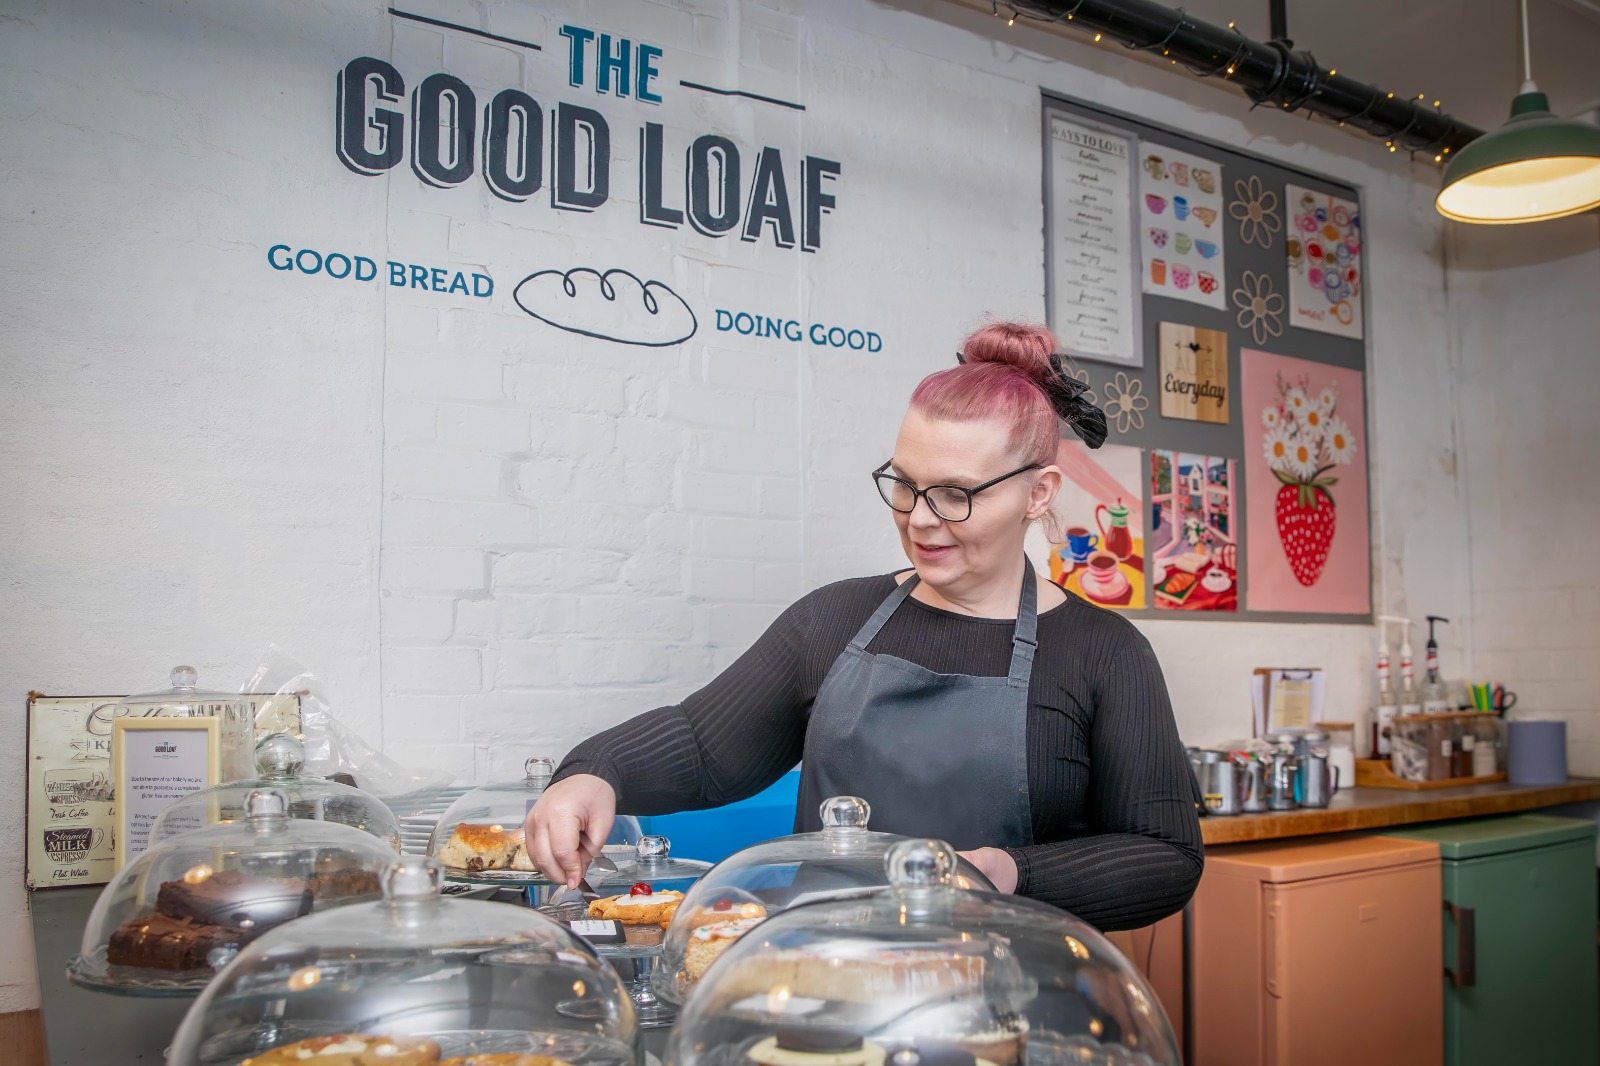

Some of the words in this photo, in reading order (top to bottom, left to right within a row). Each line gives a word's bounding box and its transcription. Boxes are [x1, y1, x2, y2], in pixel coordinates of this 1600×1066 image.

[559, 24, 664, 104] THE
[1051, 125, 1081, 143] WAYS
[1081, 133, 1097, 147] TO
[1099, 138, 1126, 154] LOVE
[335, 56, 611, 213] GOOD
[639, 121, 842, 254] LOAF
[266, 244, 379, 283] GOOD
[387, 260, 495, 299] BREAD
[715, 309, 803, 342] DOING
[808, 322, 884, 354] GOOD
[1165, 373, 1226, 408] Everyday
[68, 808, 89, 818] Coffee
[46, 830, 90, 842] Steamed
[49, 840, 88, 852] MILK
[50, 850, 86, 862] ESPRESSO
[52, 869, 69, 878] Flat
[70, 868, 89, 877] White
